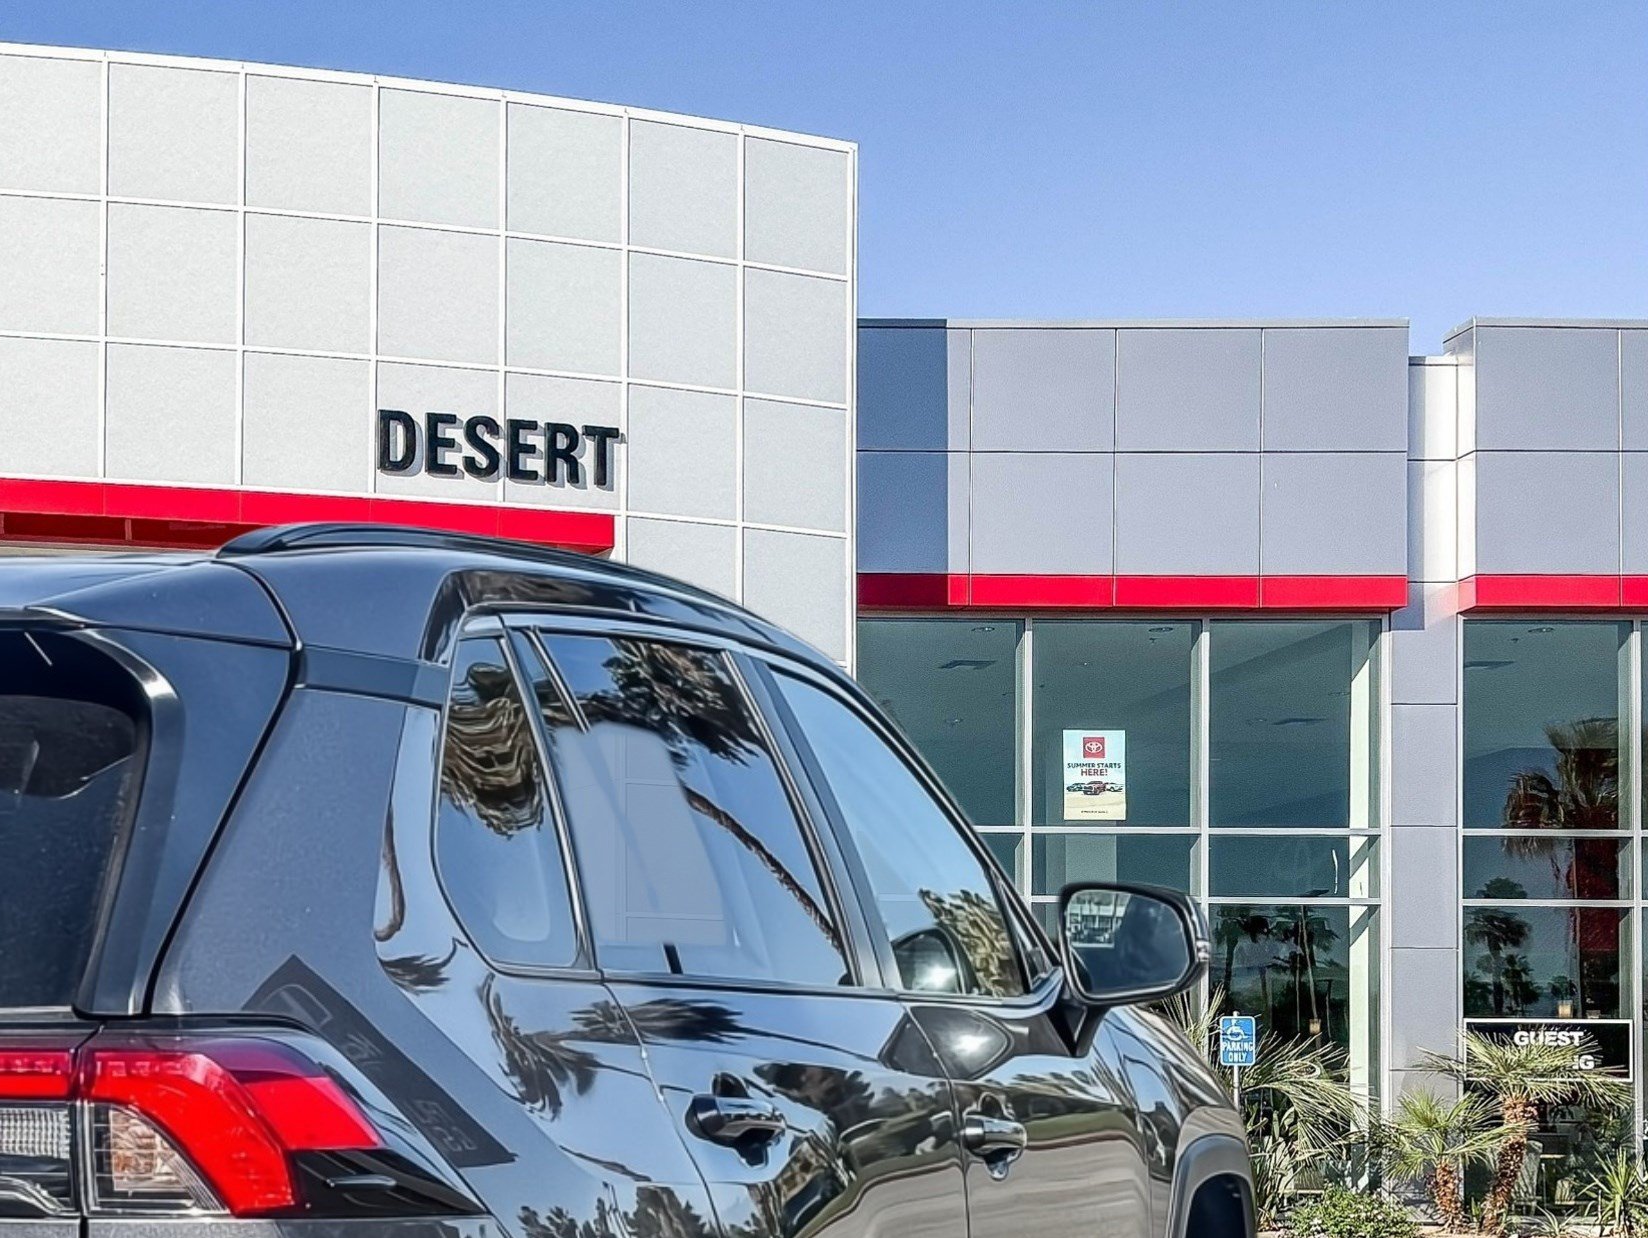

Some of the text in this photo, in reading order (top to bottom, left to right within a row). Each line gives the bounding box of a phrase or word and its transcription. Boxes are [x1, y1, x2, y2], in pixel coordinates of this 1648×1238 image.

[377, 409, 620, 486] DESERT
[1080, 768, 1108, 777] HERE!
[1513, 1030, 1584, 1047] GUEST
[1221, 1040, 1254, 1052] PARKING
[1228, 1051, 1248, 1063] ONLY
